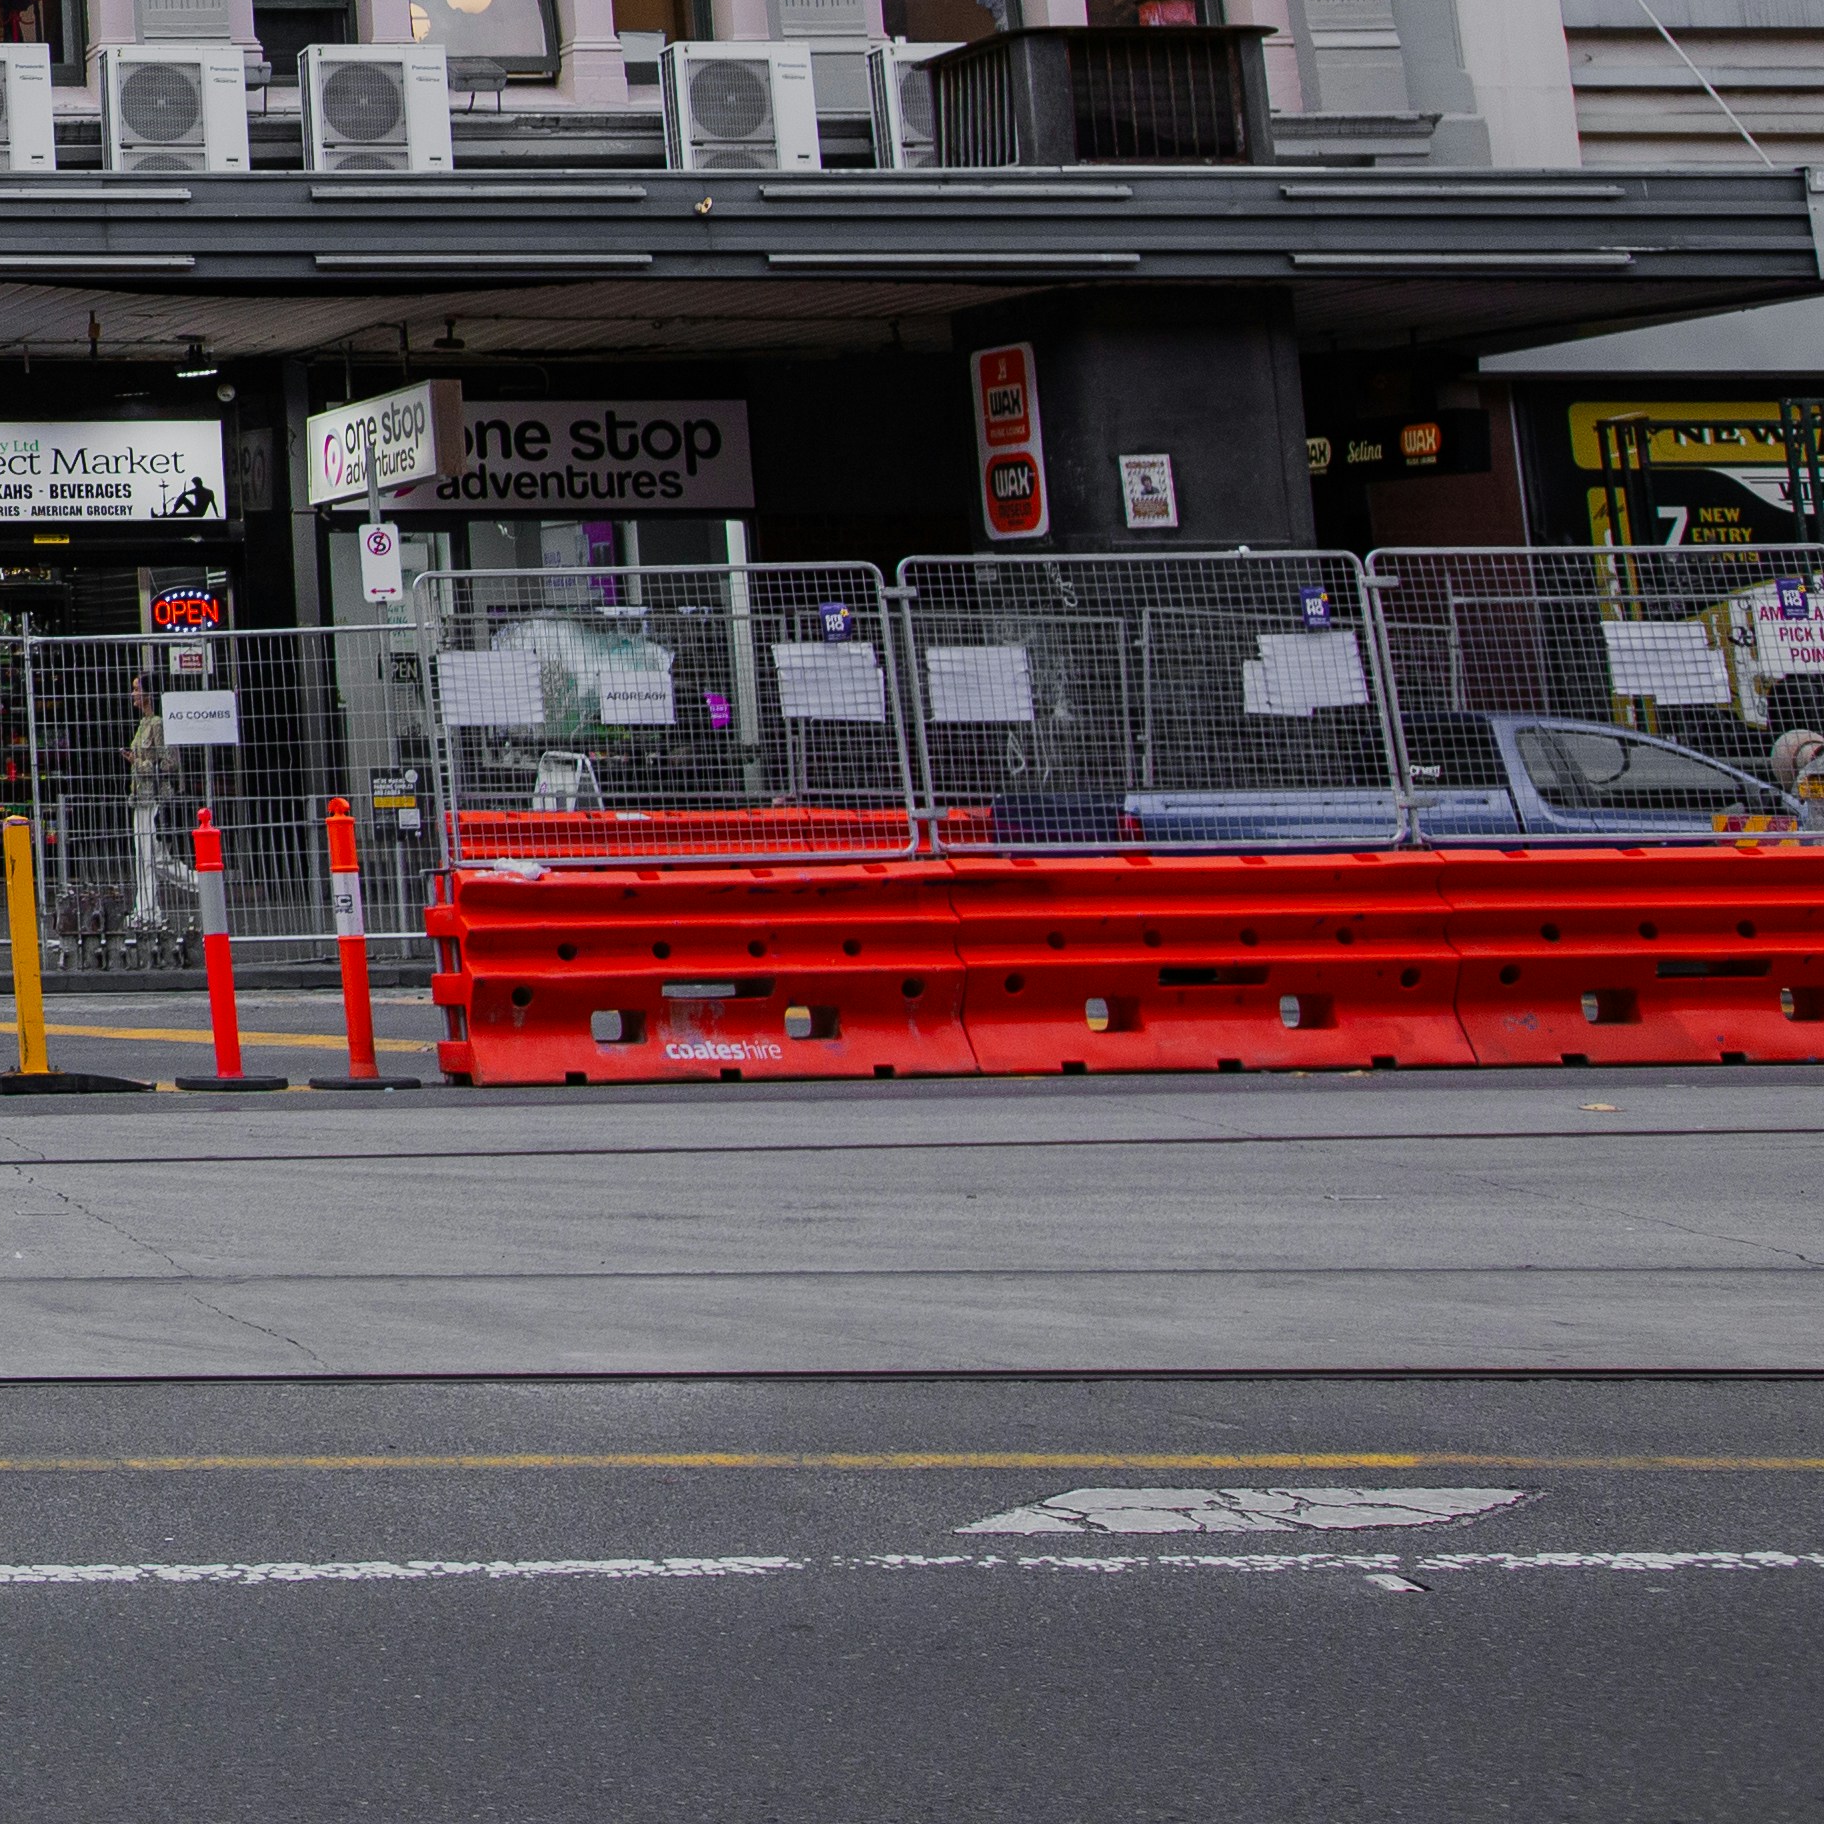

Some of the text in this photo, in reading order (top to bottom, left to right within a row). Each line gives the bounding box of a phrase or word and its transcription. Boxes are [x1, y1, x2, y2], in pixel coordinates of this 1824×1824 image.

[989, 388, 1022, 417] WAX
[345, 400, 425, 451] one stop
[12, 439, 40, 453] Ltd
[569, 409, 722, 476] stop
[1404, 428, 1436, 453] WAX
[49, 446, 186, 476] Market
[1308, 442, 1328, 465] AX
[345, 447, 416, 486] advntures
[49, 483, 132, 500] BEVERAGES
[435, 463, 684, 501] adventures
[995, 466, 1030, 498] WAX
[30, 505, 83, 517] AMERICAN
[86, 504, 134, 517] GROCERY
[1698, 506, 1742, 523] NEW
[1691, 527, 1754, 544] ENTRY
[154, 598, 220, 625] OPEN
[1779, 626, 1814, 642] PICK
[392, 661, 417, 679] PEN
[168, 710, 231, 720] AG COOMBS
[665, 1040, 783, 1060] coateshire
